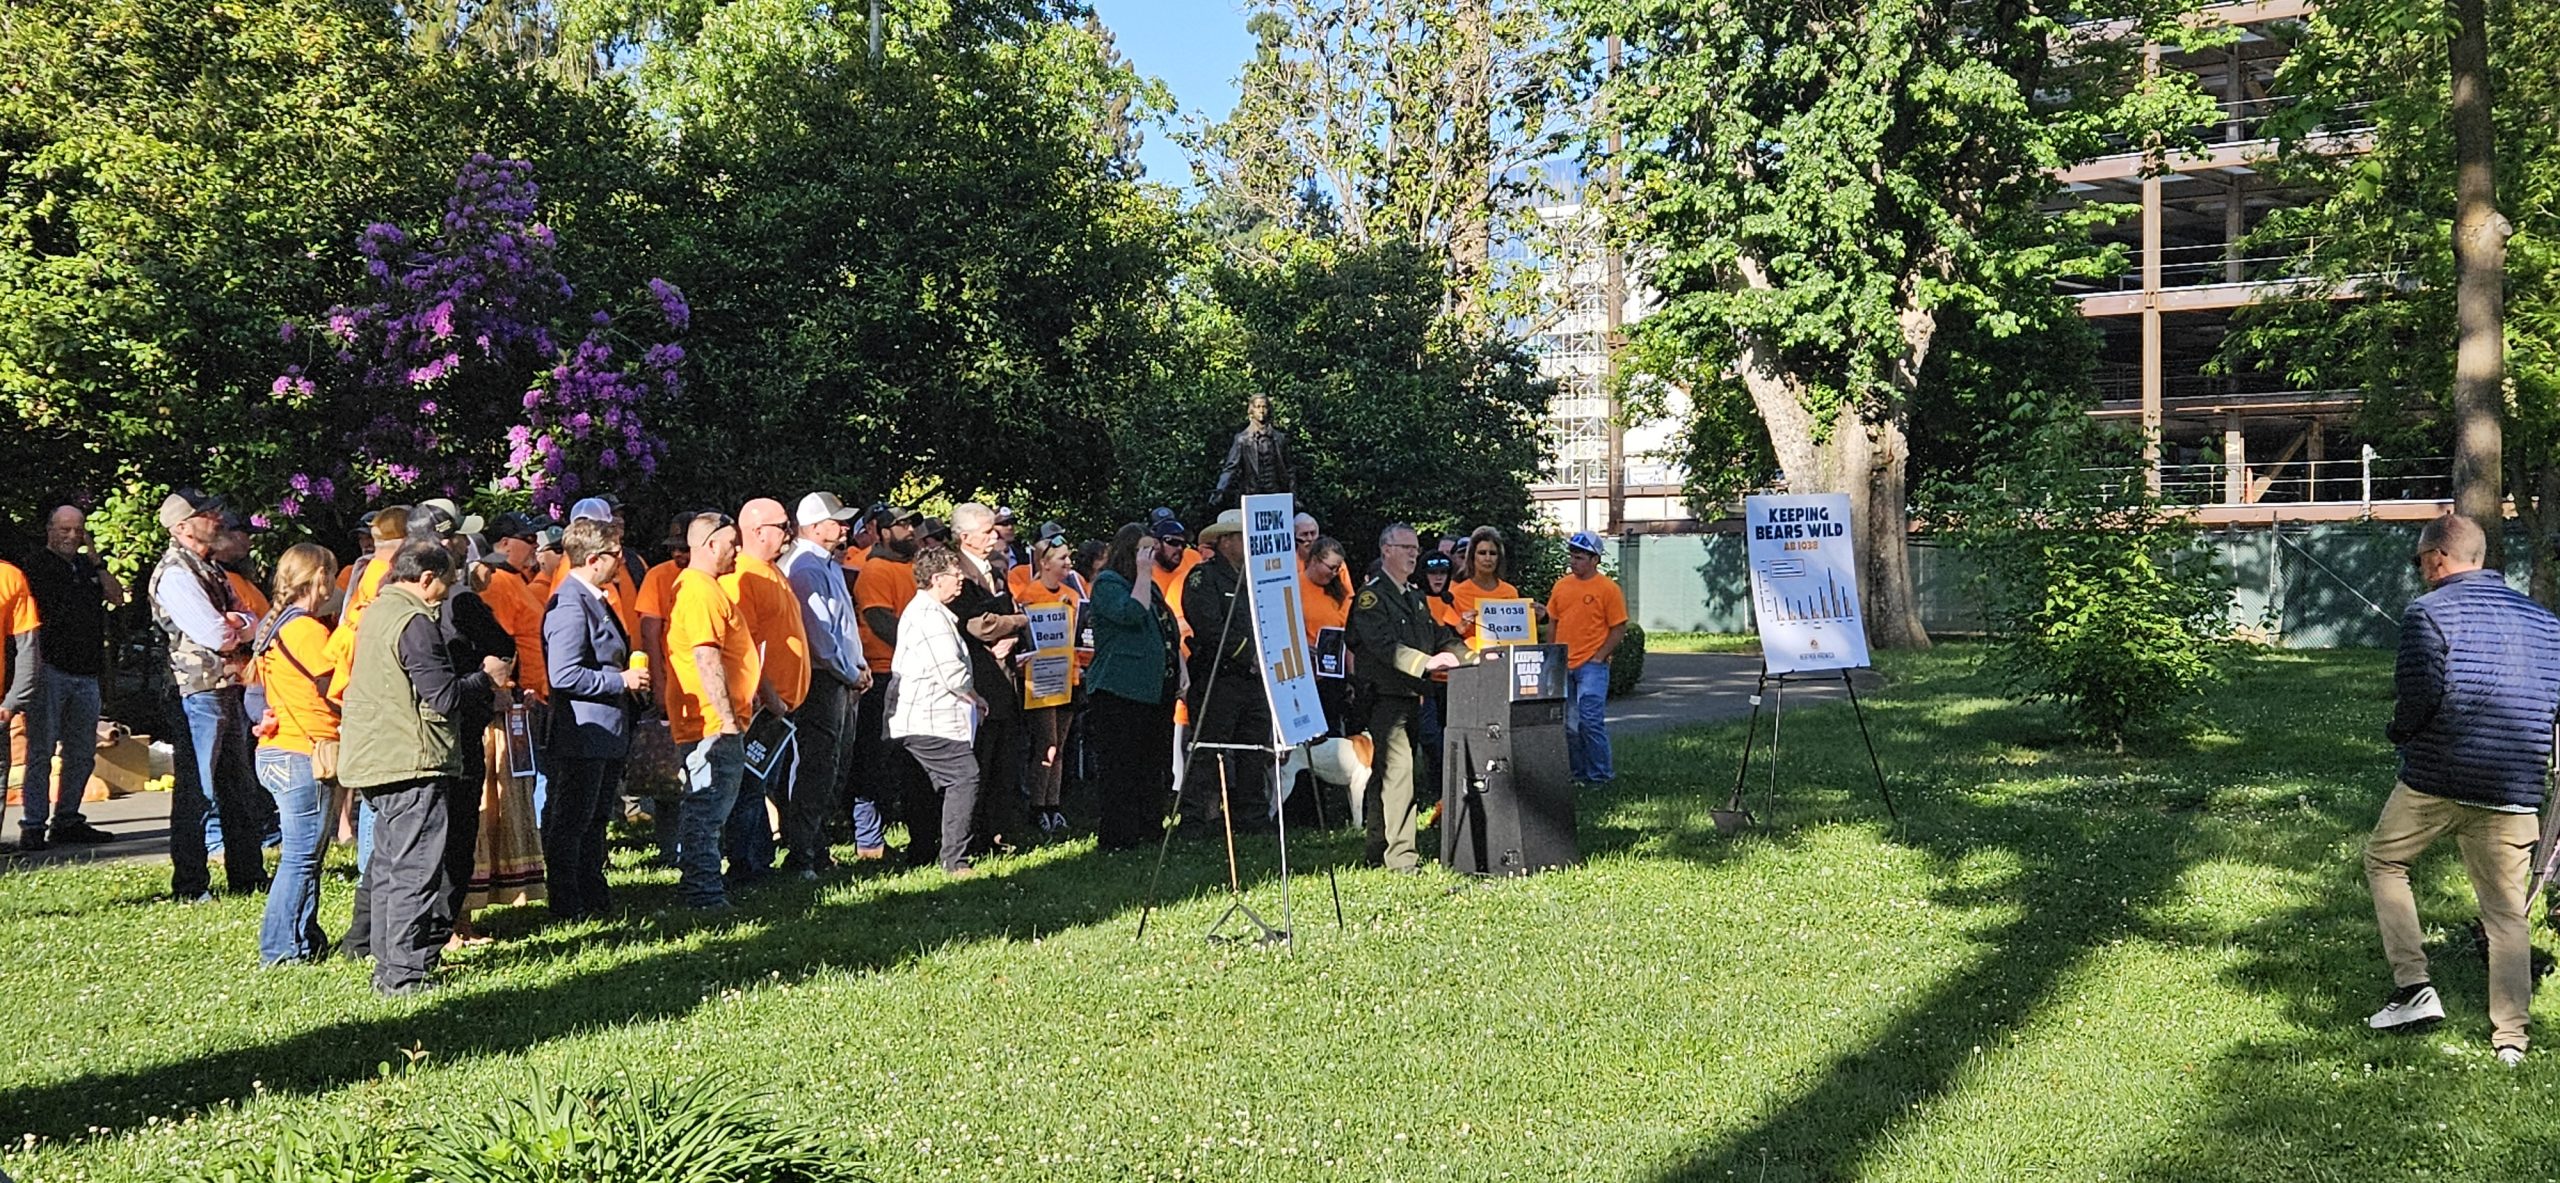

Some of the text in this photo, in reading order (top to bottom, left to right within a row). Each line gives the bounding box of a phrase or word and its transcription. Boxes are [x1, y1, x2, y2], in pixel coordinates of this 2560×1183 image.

[1254, 510, 1284, 531] KEEPING
[1769, 507, 1829, 523] KEEPING
[1755, 522, 1843, 540] BEARS WILD
[1249, 532, 1292, 556] BEARS WILD
[1784, 540, 1819, 551] AB 1038
[1484, 607, 1524, 615] AB 1038
[1031, 612, 1066, 623] AB 1038
[1488, 623, 1522, 632] Bears
[1036, 631, 1064, 641] Bears
